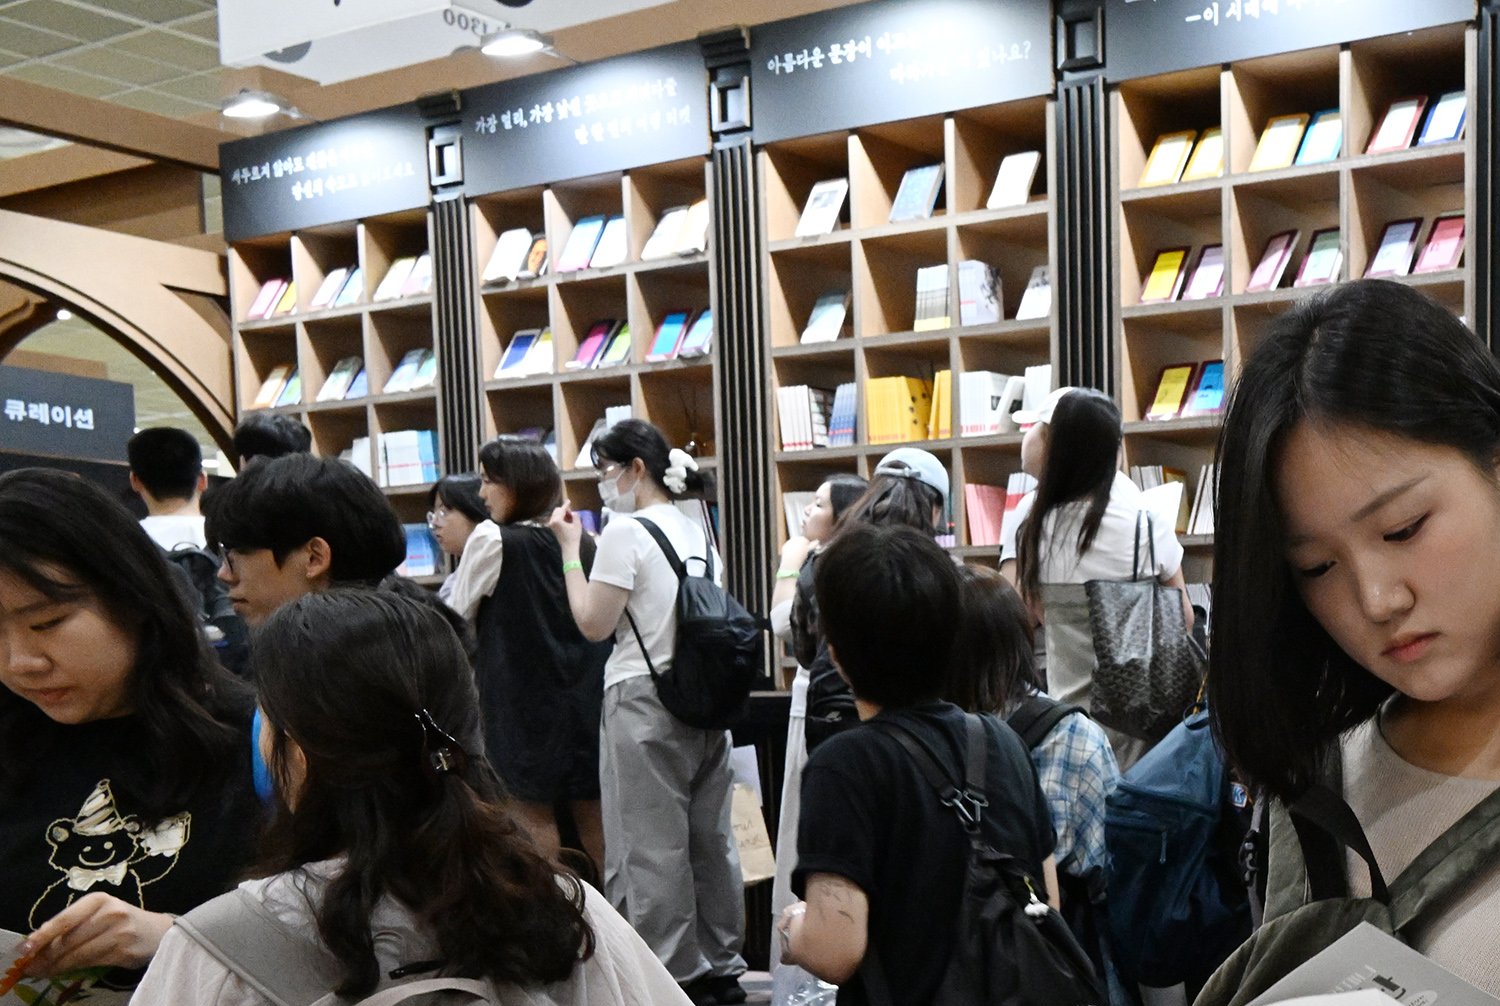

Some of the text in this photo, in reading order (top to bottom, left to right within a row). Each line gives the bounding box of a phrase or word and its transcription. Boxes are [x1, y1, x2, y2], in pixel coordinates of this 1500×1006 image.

[767, 46, 825, 75] 아름다운
[828, 36, 872, 65] 문장이
[475, 114, 497, 134] 가장
[529, 102, 553, 123] 가장
[4, 399, 94, 430] 큐레이션
